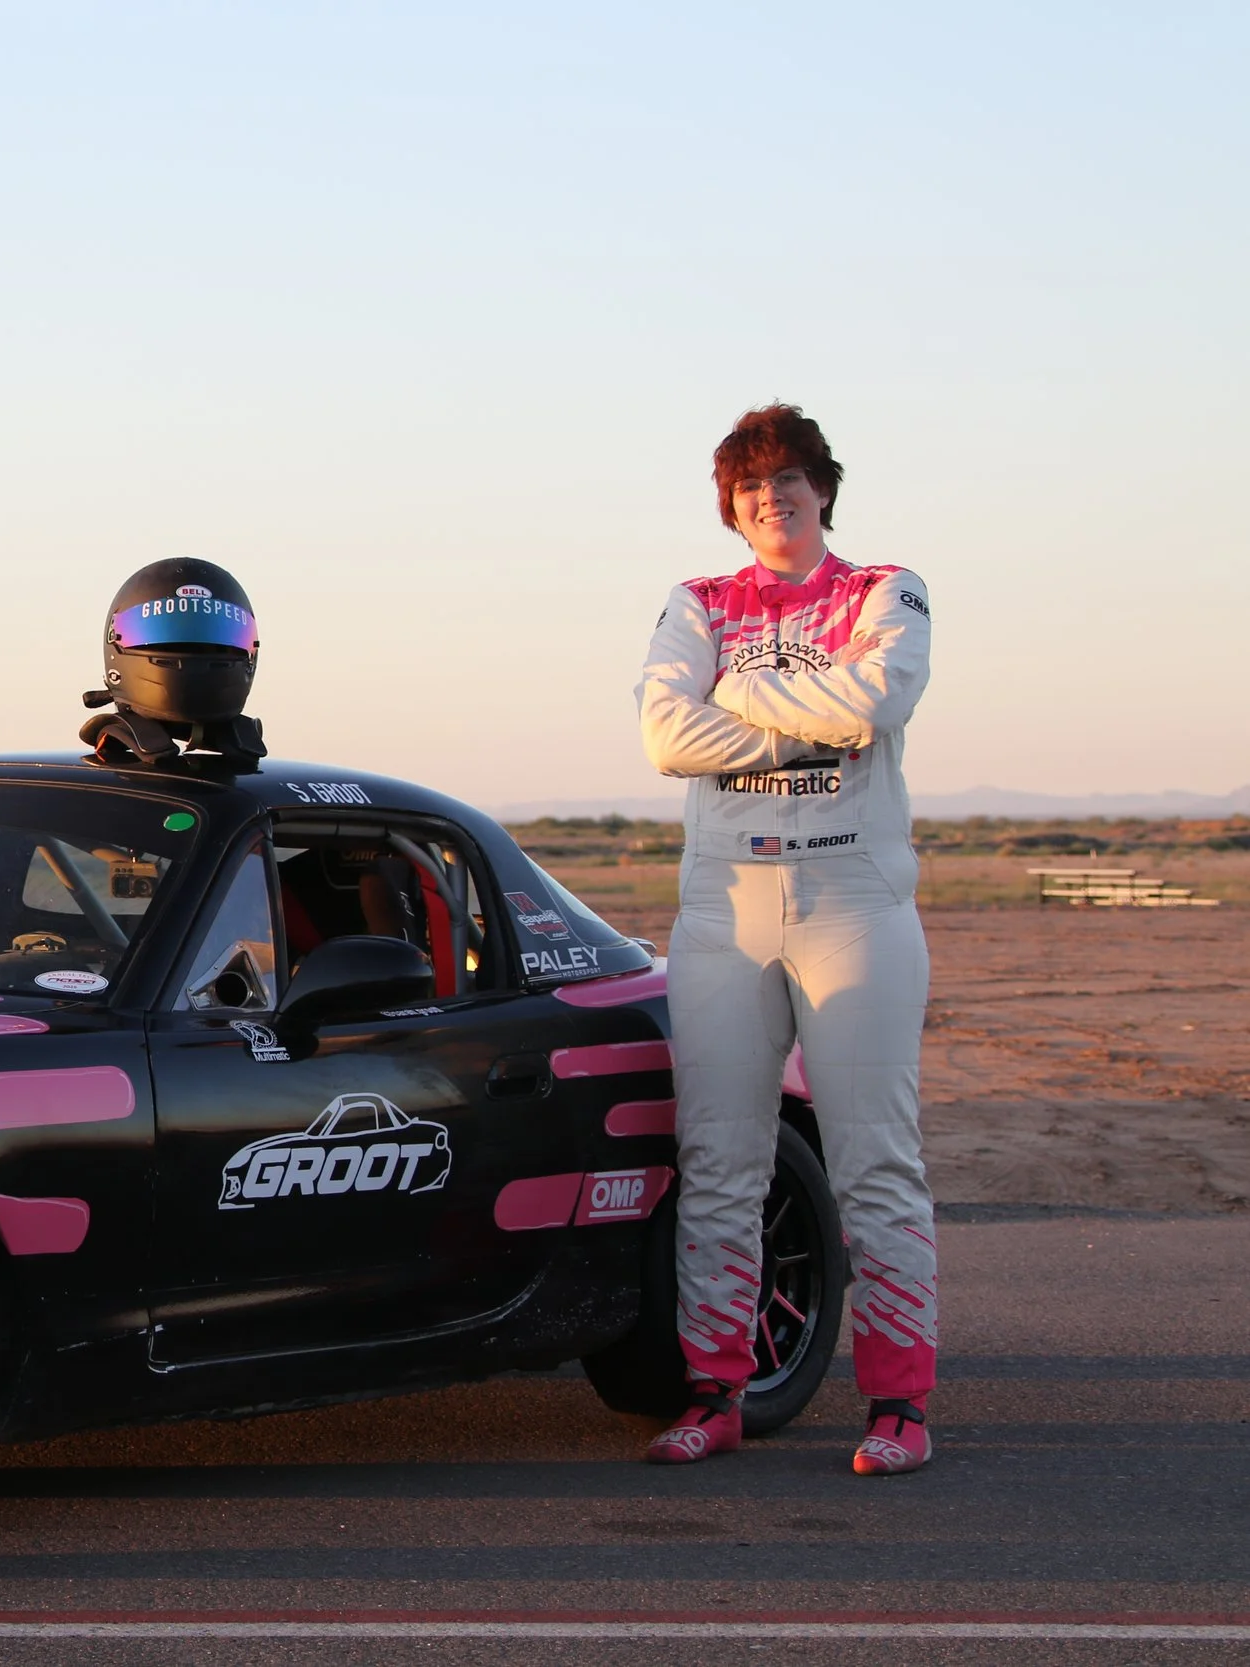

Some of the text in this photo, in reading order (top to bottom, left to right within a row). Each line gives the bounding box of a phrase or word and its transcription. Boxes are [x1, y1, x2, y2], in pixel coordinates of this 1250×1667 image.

[182, 588, 208, 596] BELL
[142, 598, 247, 625] GROOTSPEED
[286, 782, 372, 804] S. GROOT
[715, 772, 841, 796] Multimatic
[786, 833, 858, 850] S. GROOT
[521, 947, 599, 975] PALEY
[562, 967, 601, 977] MOTORSPORT
[253, 1051, 290, 1062] Multimatic
[241, 1143, 434, 1198] GROOT
[591, 1179, 644, 1208] OMP
